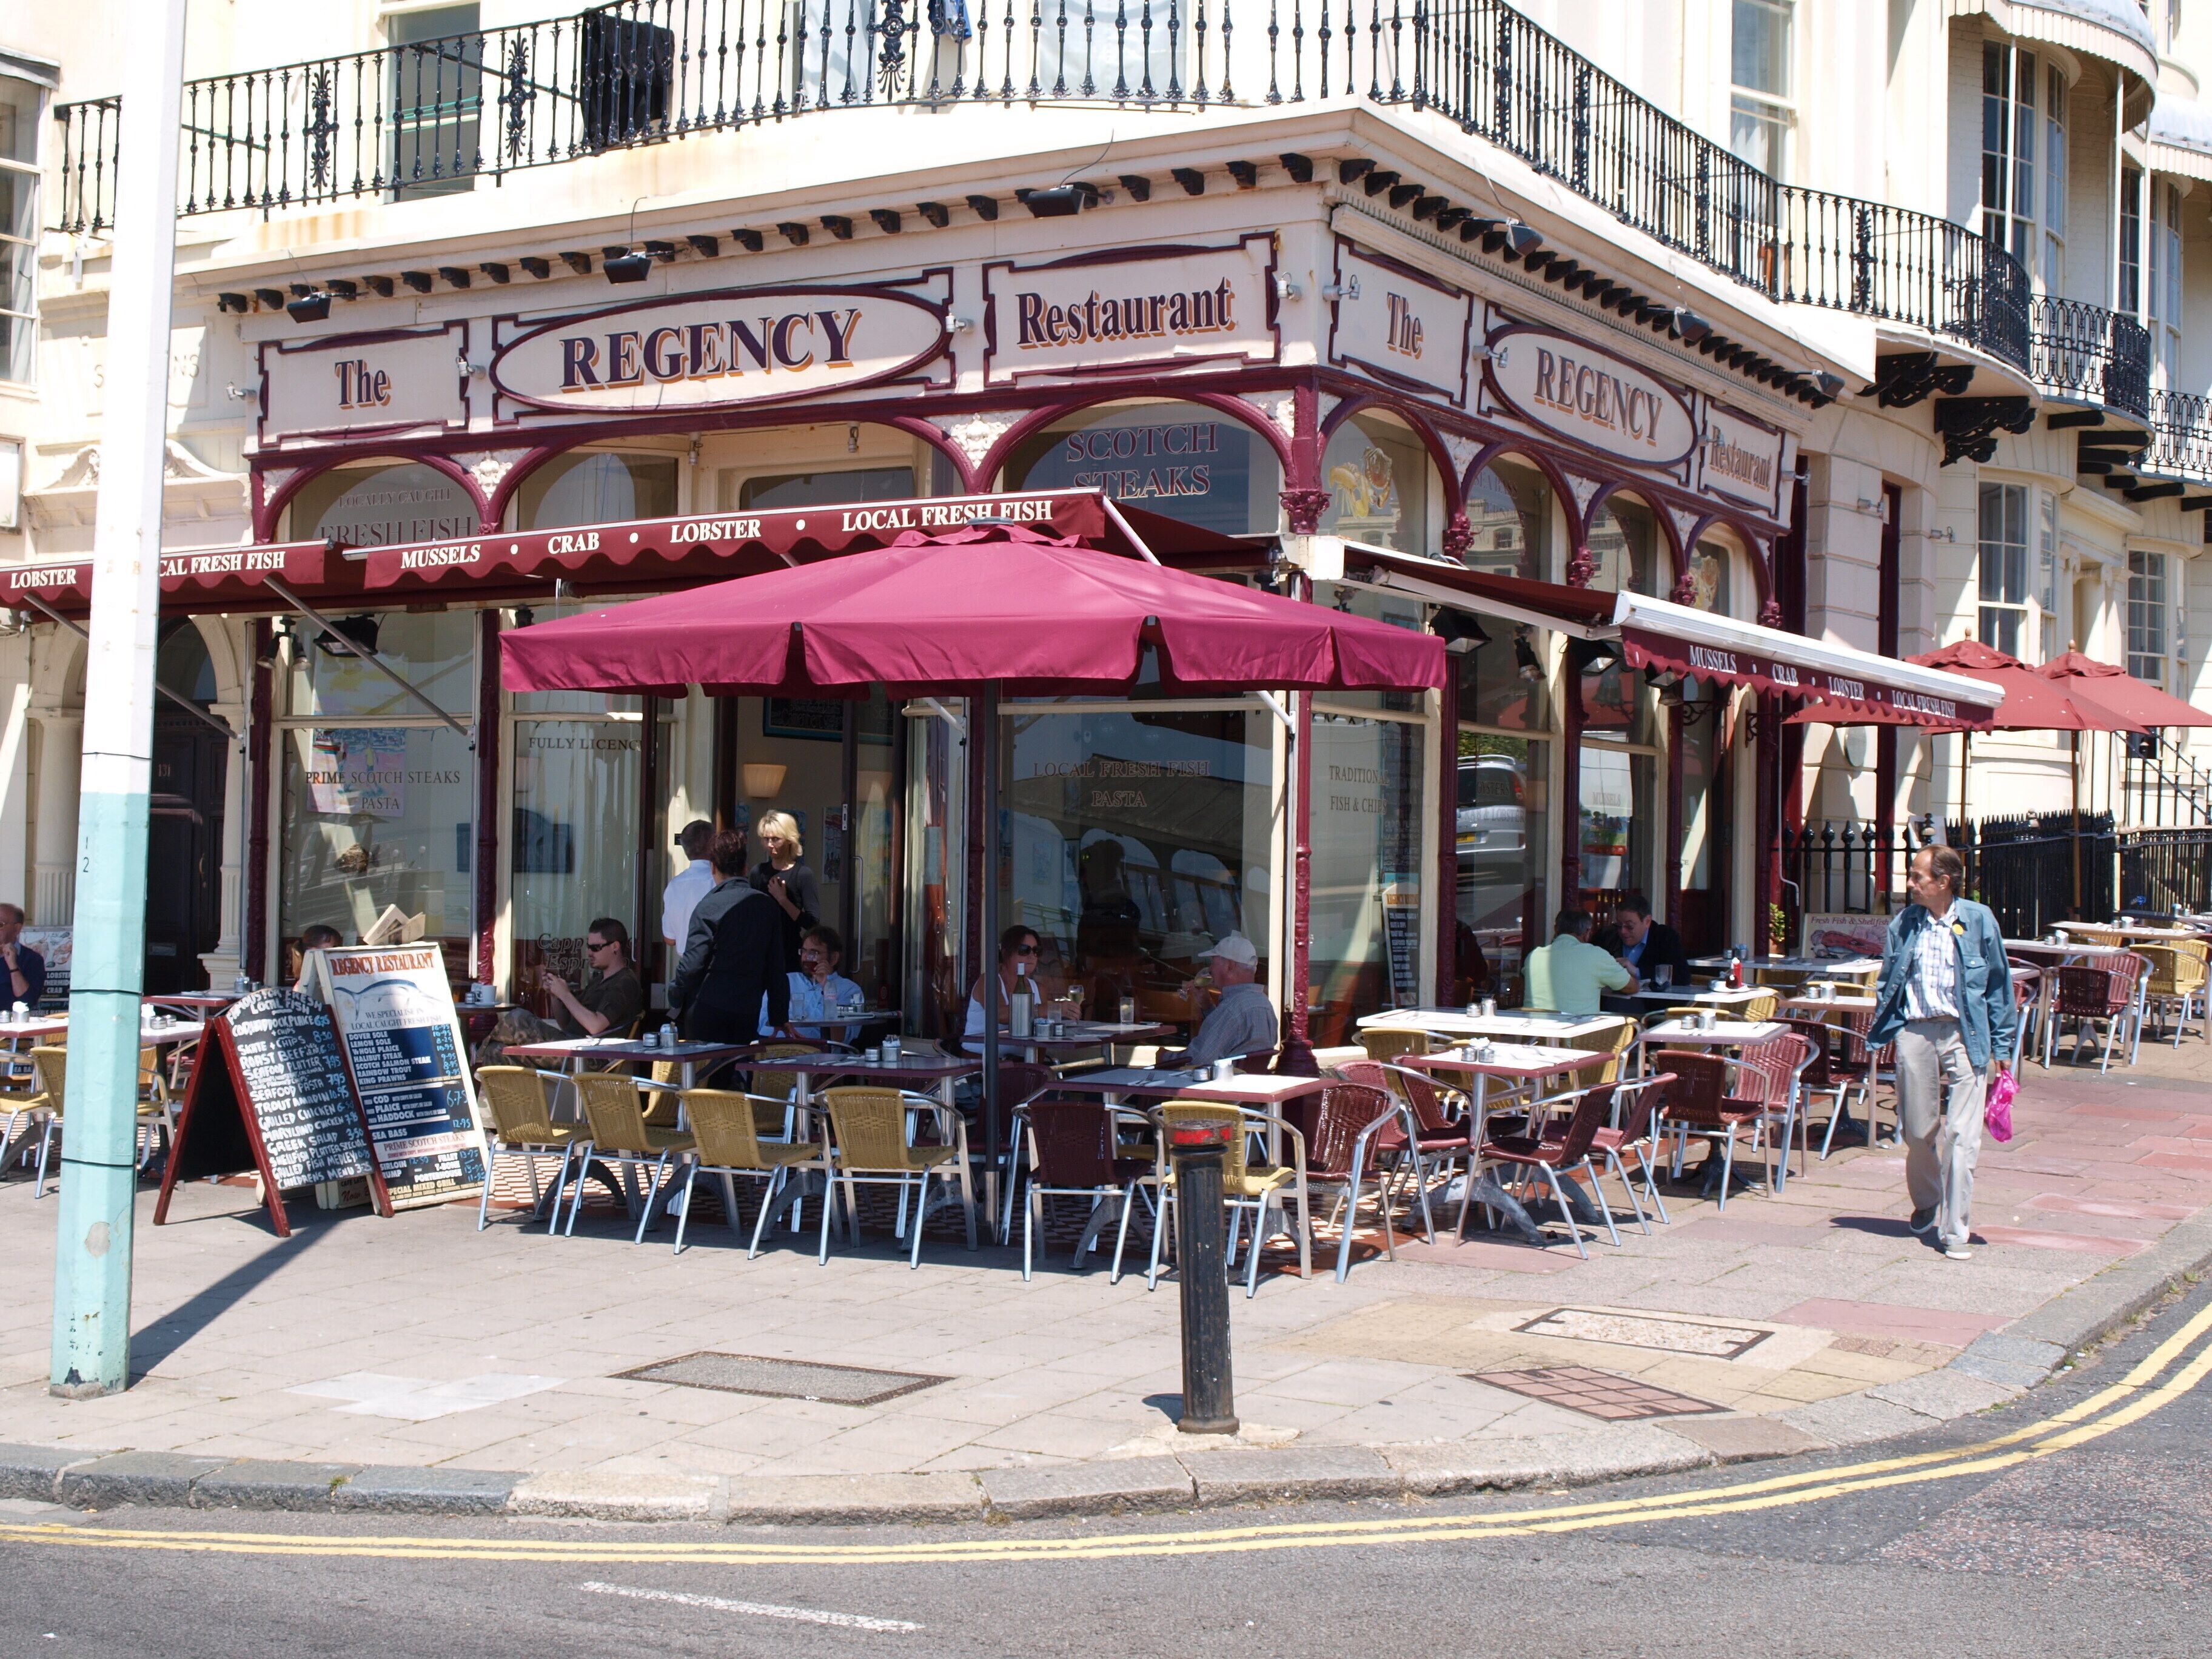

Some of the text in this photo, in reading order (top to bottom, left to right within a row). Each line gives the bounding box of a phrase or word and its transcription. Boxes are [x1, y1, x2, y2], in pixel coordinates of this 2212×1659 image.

[1017, 276, 1236, 349] Restaurant
[1387, 292, 1423, 359] The
[559, 308, 863, 394] REGENCY
[335, 358, 391, 409] The
[1534, 347, 1663, 446] REGENCY
[1066, 423, 1218, 463] SCOTCH
[1709, 426, 1774, 492] Restaurant
[1074, 465, 1211, 500] STEAKS
[338, 488, 452, 508] LOCALLY CAUGHT
[842, 500, 1053, 532] LOCAL FRESH FISH
[321, 517, 472, 546] FRESH FISH
[401, 519, 762, 569] MUSSELS CRAB LOBSTER
[10, 551, 286, 589] LOBSTER CAL FRESH FISH
[1689, 645, 1956, 719] MUSSELS CRAB LOBSTER LOCAL FRESH FISH
[529, 737, 575, 749] FULLY
[306, 771, 460, 784] PRIME SCOTCH STEAKS
[1033, 760, 1211, 777] LOCAL FRESH FISH
[1329, 765, 1390, 785] TRADITIONAL
[1477, 781, 1510, 796] OYSTERS
[362, 797, 400, 809] PASTA
[1091, 791, 1147, 807] PASTA
[1330, 796, 1387, 814] FISH & CHIPS
[1811, 916, 1829, 924] Fresh
[1858, 917, 1889, 927] Shellfish
[330, 953, 435, 976] REGENCY RESTAURANT
[250, 997, 310, 1015] LOCAL FISH
[286, 990, 323, 1012] FRESH
[351, 1021, 374, 1030] LOCAL
[375, 1019, 403, 1029] CAUGHT
[237, 1041, 267, 1056] SKATE
[276, 1035, 307, 1048] CHIPS
[378, 1045, 400, 1053] PLAICE
[240, 1051, 275, 1070] ROAST
[278, 1048, 305, 1062] BEEF
[354, 1054, 381, 1062] HALIBUT
[356, 1056, 431, 1070] SCOTCH SALMON STEAK
[243, 1063, 284, 1081] SEAFOOD
[286, 1056, 323, 1072] PLATTER
[357, 1068, 389, 1078] RAINBOW
[358, 1076, 377, 1085] KING
[378, 1074, 406, 1083] PRAWNS
[249, 1085, 296, 1102] SEAFOOD
[298, 1079, 324, 1093] PASTA
[373, 1095, 389, 1104] COD
[255, 1098, 291, 1116] TROUT
[375, 1103, 401, 1113] PLAICE
[377, 1110, 415, 1122] HADDOCK
[258, 1113, 295, 1132] GRILLED
[297, 1103, 335, 1121] CHICKEN
[262, 1123, 313, 1142] MARYLAND
[315, 1116, 344, 1130] CHICKEN
[372, 1128, 407, 1140] SEA BASS
[267, 1138, 307, 1156] GREEK
[308, 1132, 338, 1147] SALAD
[309, 1144, 341, 1158] PLATTER
[384, 1141, 408, 1151] PRIME
[408, 1137, 437, 1148] SCOTCH
[307, 1158, 324, 1171] FISH
[327, 1150, 357, 1165] MEDLEY
[380, 1160, 407, 1171] SIRLOIN
[327, 1165, 354, 1180] MENU
[388, 1185, 413, 1196] PECIAL
[413, 1182, 436, 1192] MIXED
[437, 1178, 456, 1188] GRILL
